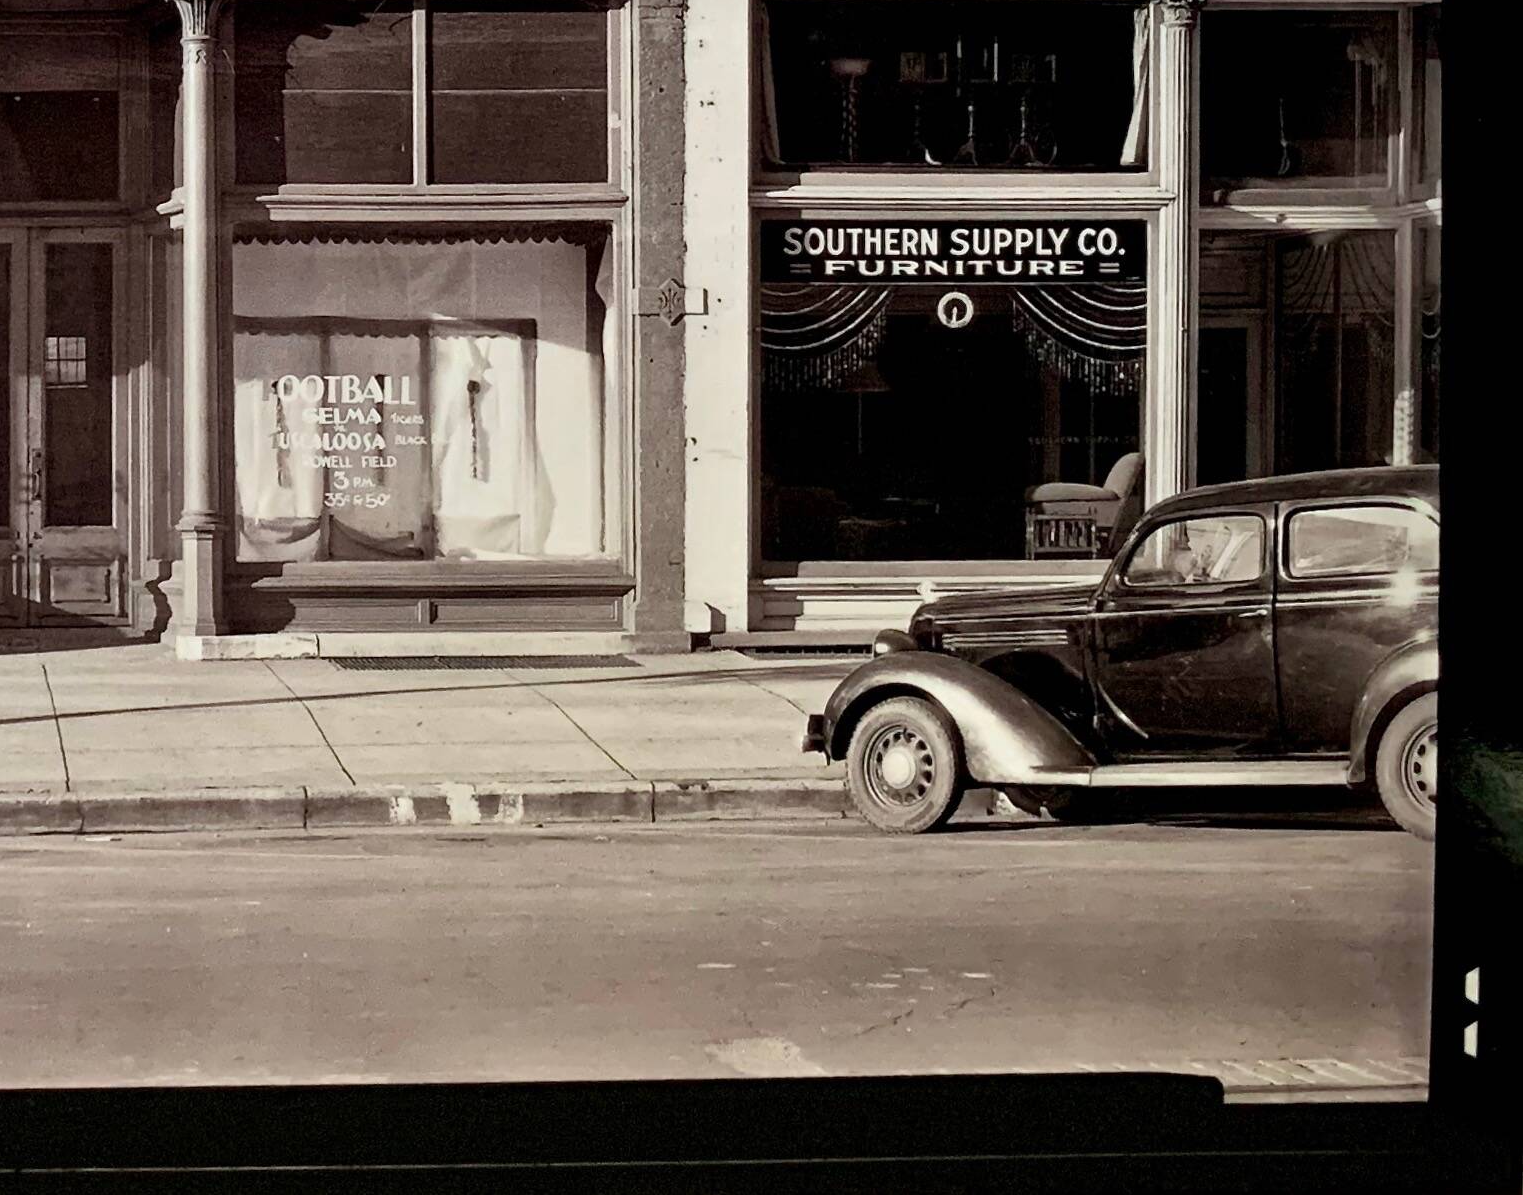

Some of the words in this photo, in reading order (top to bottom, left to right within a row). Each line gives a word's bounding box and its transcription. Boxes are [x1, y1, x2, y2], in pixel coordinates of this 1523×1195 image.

[783, 227, 939, 257] SOUTHERN
[949, 227, 1070, 257] SUPPLY
[1077, 227, 1127, 257] CO.
[823, 260, 1085, 276] FURNITURE
[301, 407, 383, 426] SELMA
[361, 455, 397, 469] FIELD
[333, 470, 350, 489] 3
